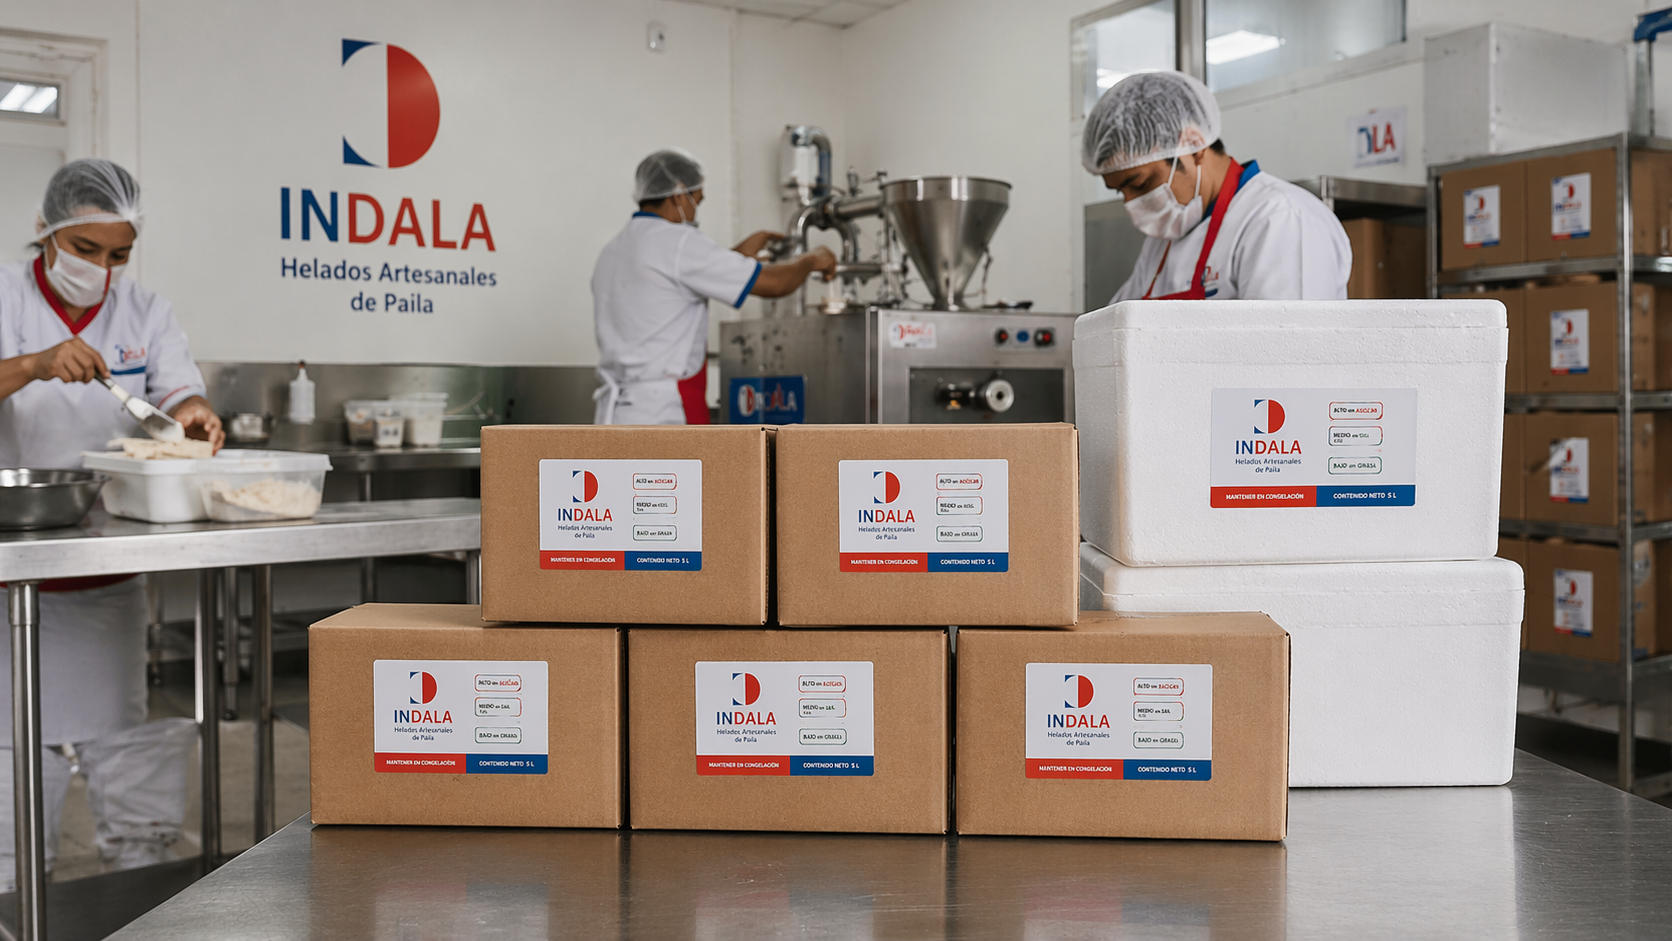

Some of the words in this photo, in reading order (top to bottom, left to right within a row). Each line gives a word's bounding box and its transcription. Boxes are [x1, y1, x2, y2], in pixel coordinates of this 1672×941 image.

[281, 187, 496, 252] INDALA
[281, 257, 372, 281] Helados
[378, 262, 497, 287] Artesanales
[350, 291, 377, 312] de
[384, 293, 434, 314] Paila
[1236, 440, 1302, 454] INDALA
[558, 508, 612, 521] INDALA
[858, 510, 915, 522] INDALA
[394, 710, 452, 723] INDALA
[716, 712, 776, 725] INDALA
[1047, 714, 1110, 728] INDALA
